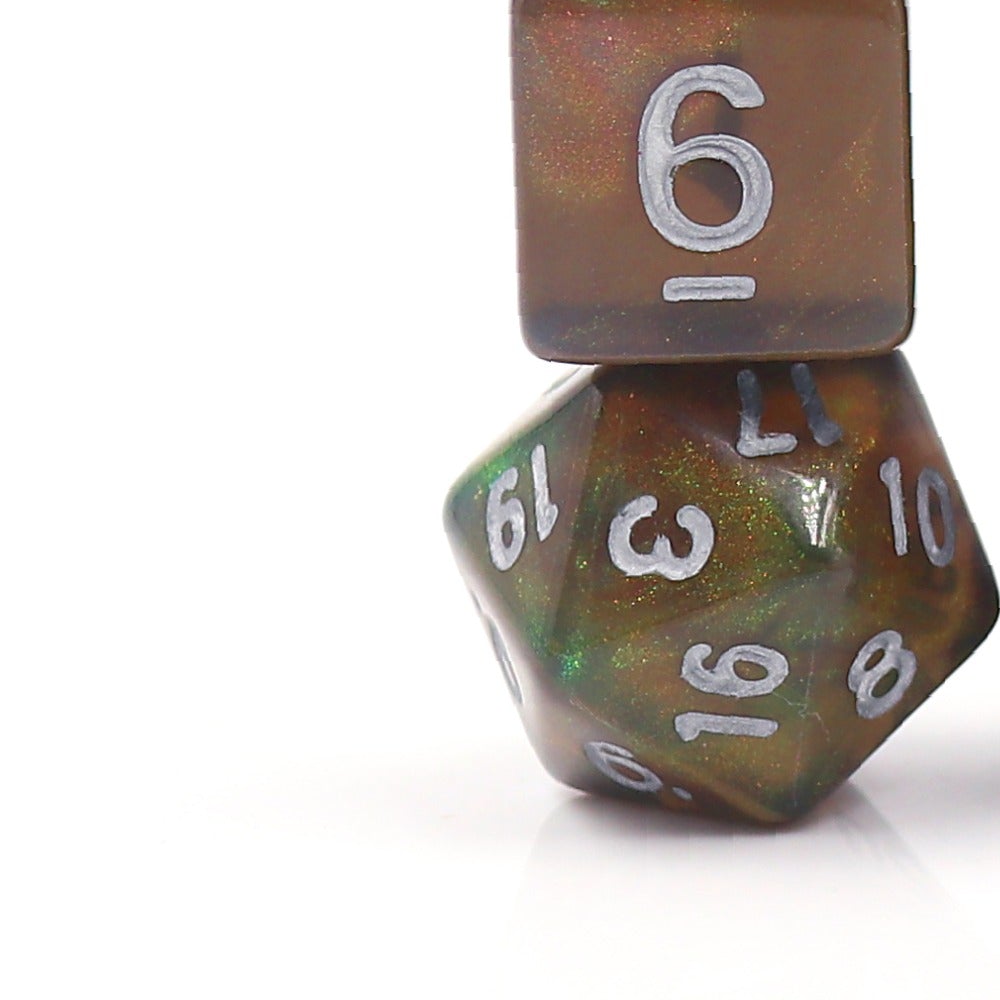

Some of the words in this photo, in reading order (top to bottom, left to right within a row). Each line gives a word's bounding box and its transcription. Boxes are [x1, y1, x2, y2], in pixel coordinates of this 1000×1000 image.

[736, 362, 843, 458] 17
[485, 443, 559, 571] 19
[607, 494, 714, 581] 3
[880, 456, 957, 567] 10
[674, 643, 790, 742] 16
[848, 630, 918, 718] 8
